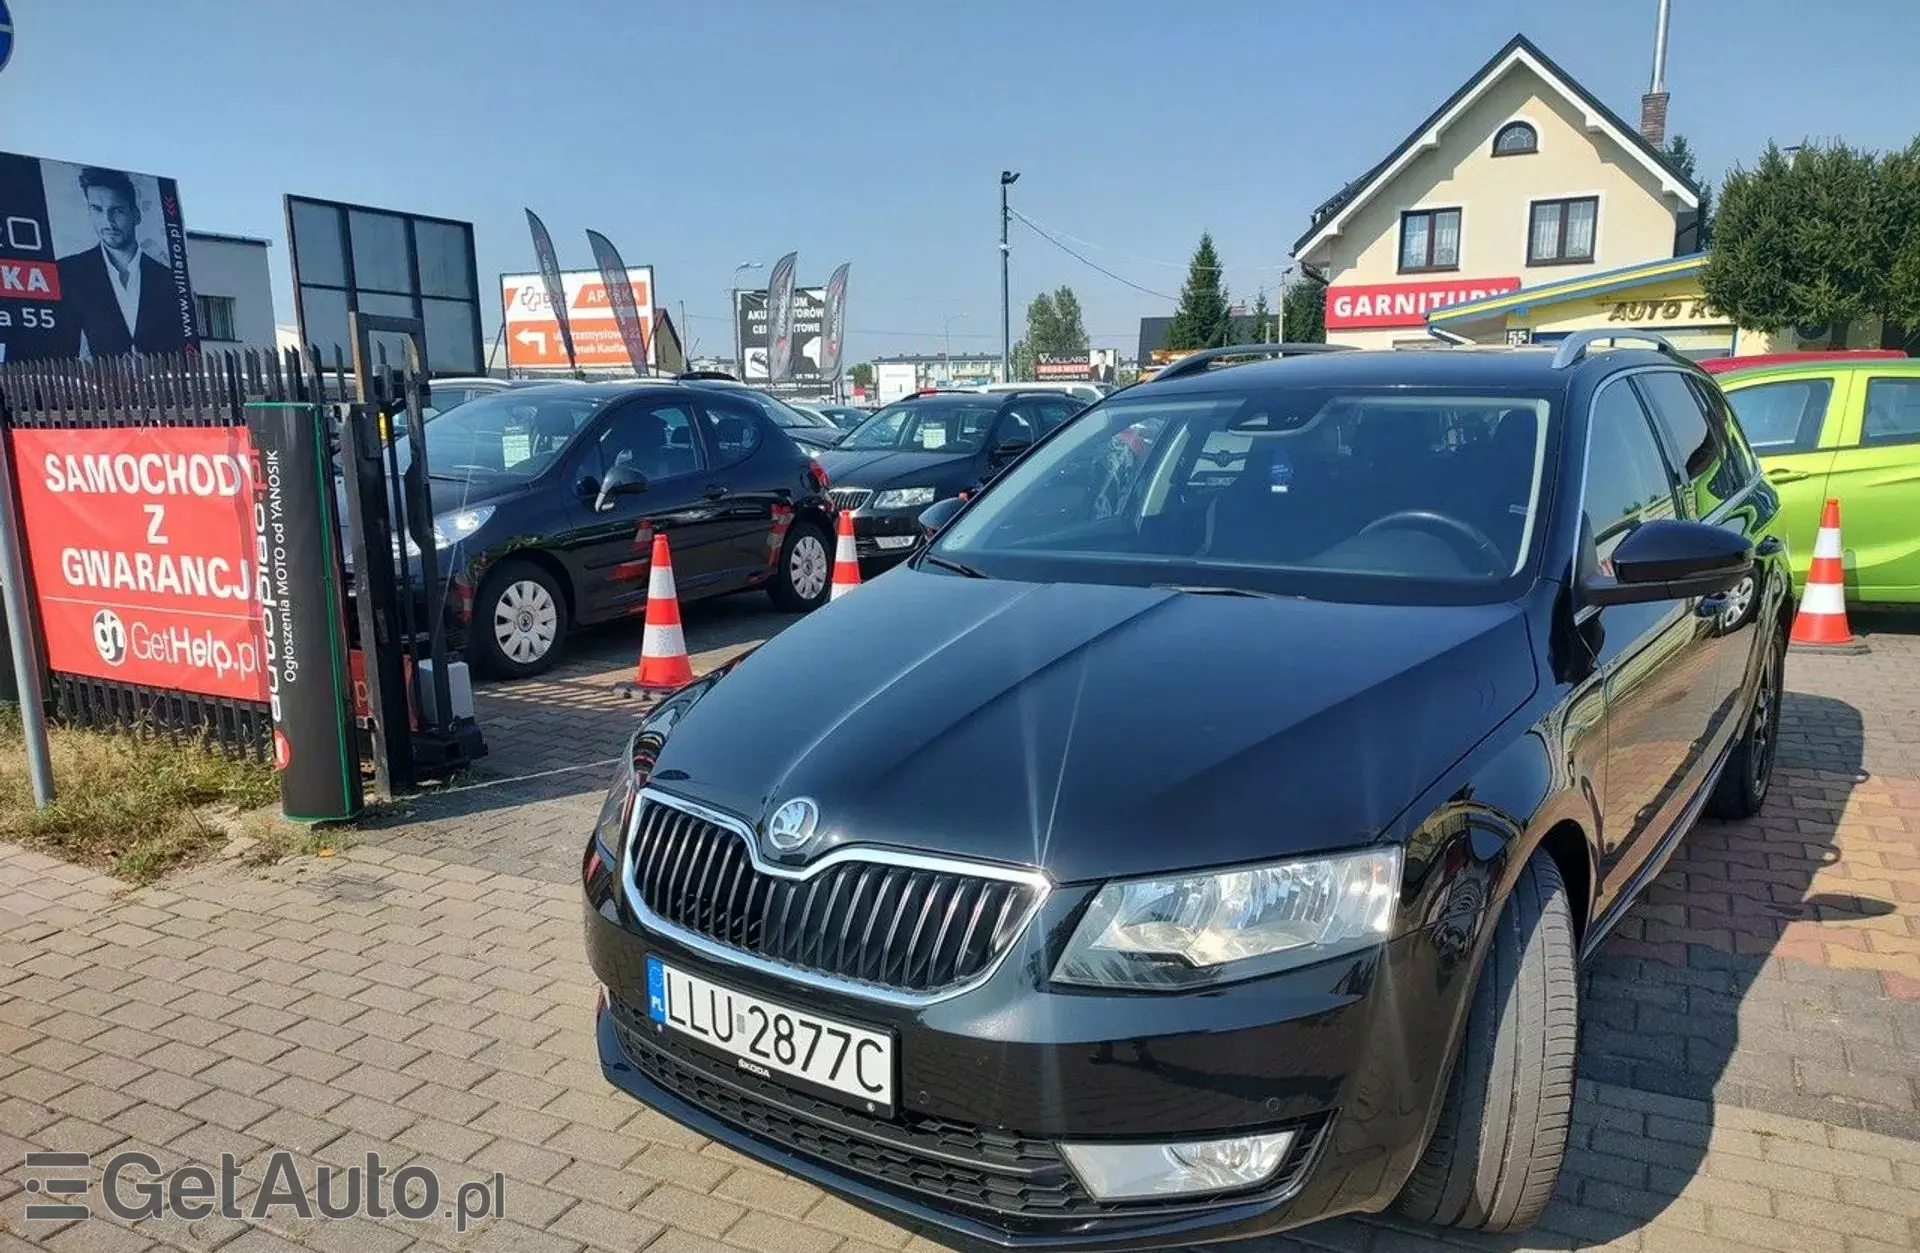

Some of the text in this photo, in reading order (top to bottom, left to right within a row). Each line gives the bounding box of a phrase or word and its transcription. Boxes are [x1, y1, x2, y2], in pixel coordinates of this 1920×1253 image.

[0, 265, 50, 293] KA
[167, 222, 192, 337] www.villaro.pl
[22, 307, 55, 328] 55
[1608, 301, 1682, 322] AUTO
[1508, 331, 1528, 345] 55
[143, 504, 168, 545] Z
[60, 547, 250, 601] GWARANCJ
[266, 449, 299, 682] Ogłoszenia MOTO od YANOSIK
[131, 621, 262, 681] GetHelp.pl
[666, 971, 885, 1094] LLU 2877C
